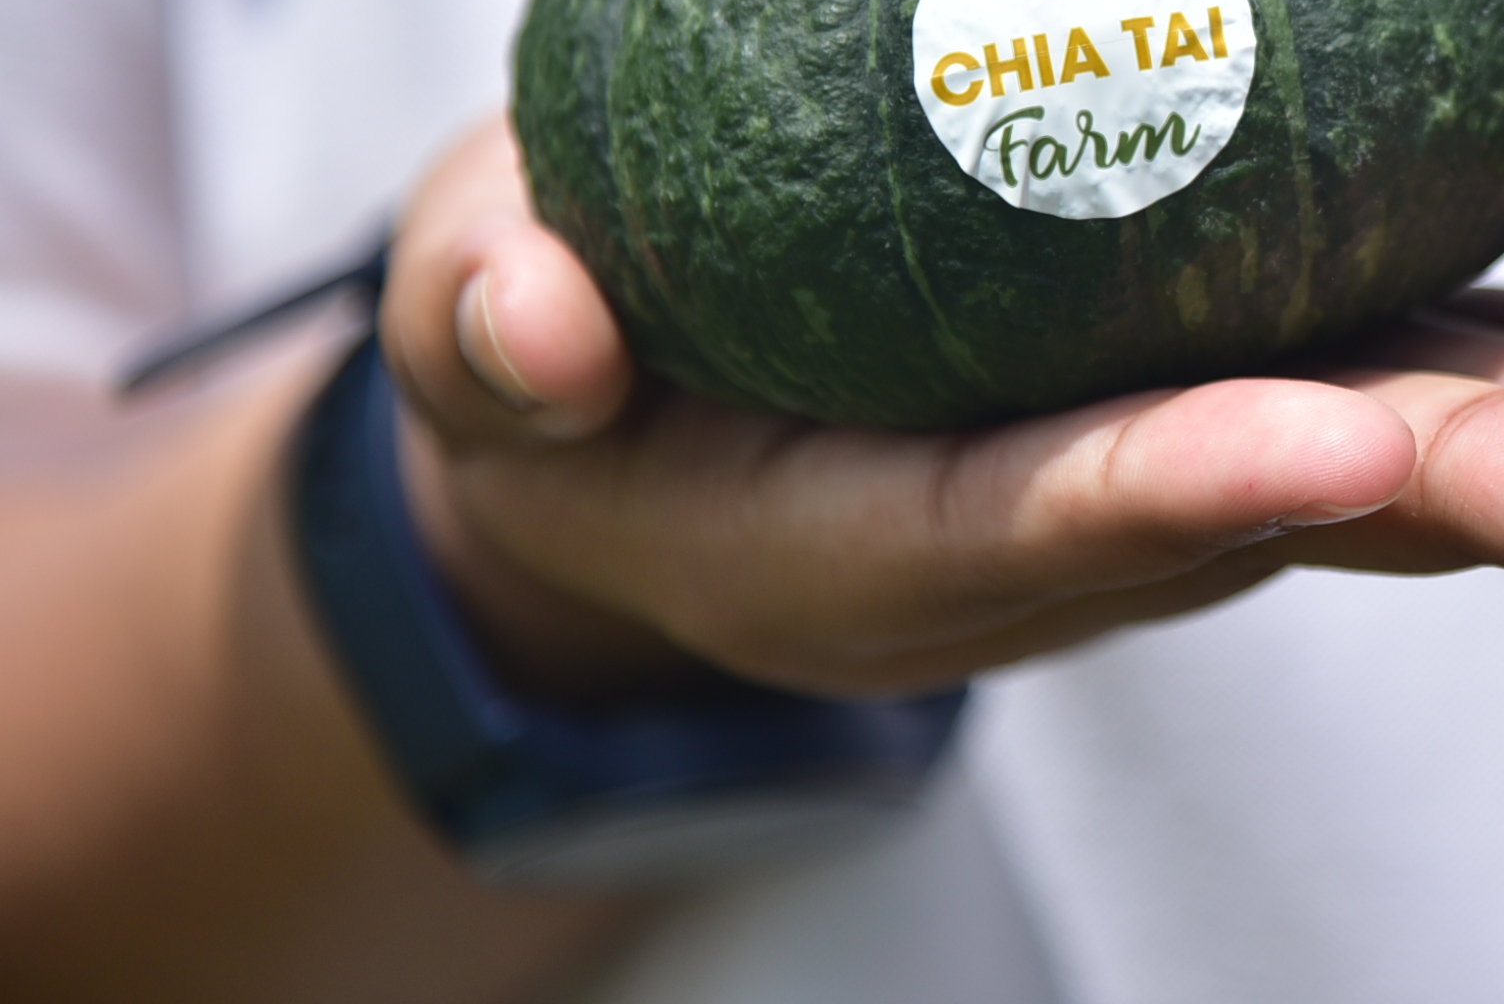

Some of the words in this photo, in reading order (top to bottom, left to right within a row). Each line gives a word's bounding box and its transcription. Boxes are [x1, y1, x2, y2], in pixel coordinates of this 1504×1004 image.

[930, 26, 1111, 106] CHIA
[1120, 5, 1229, 72] TAI
[983, 105, 1202, 188] Farm
